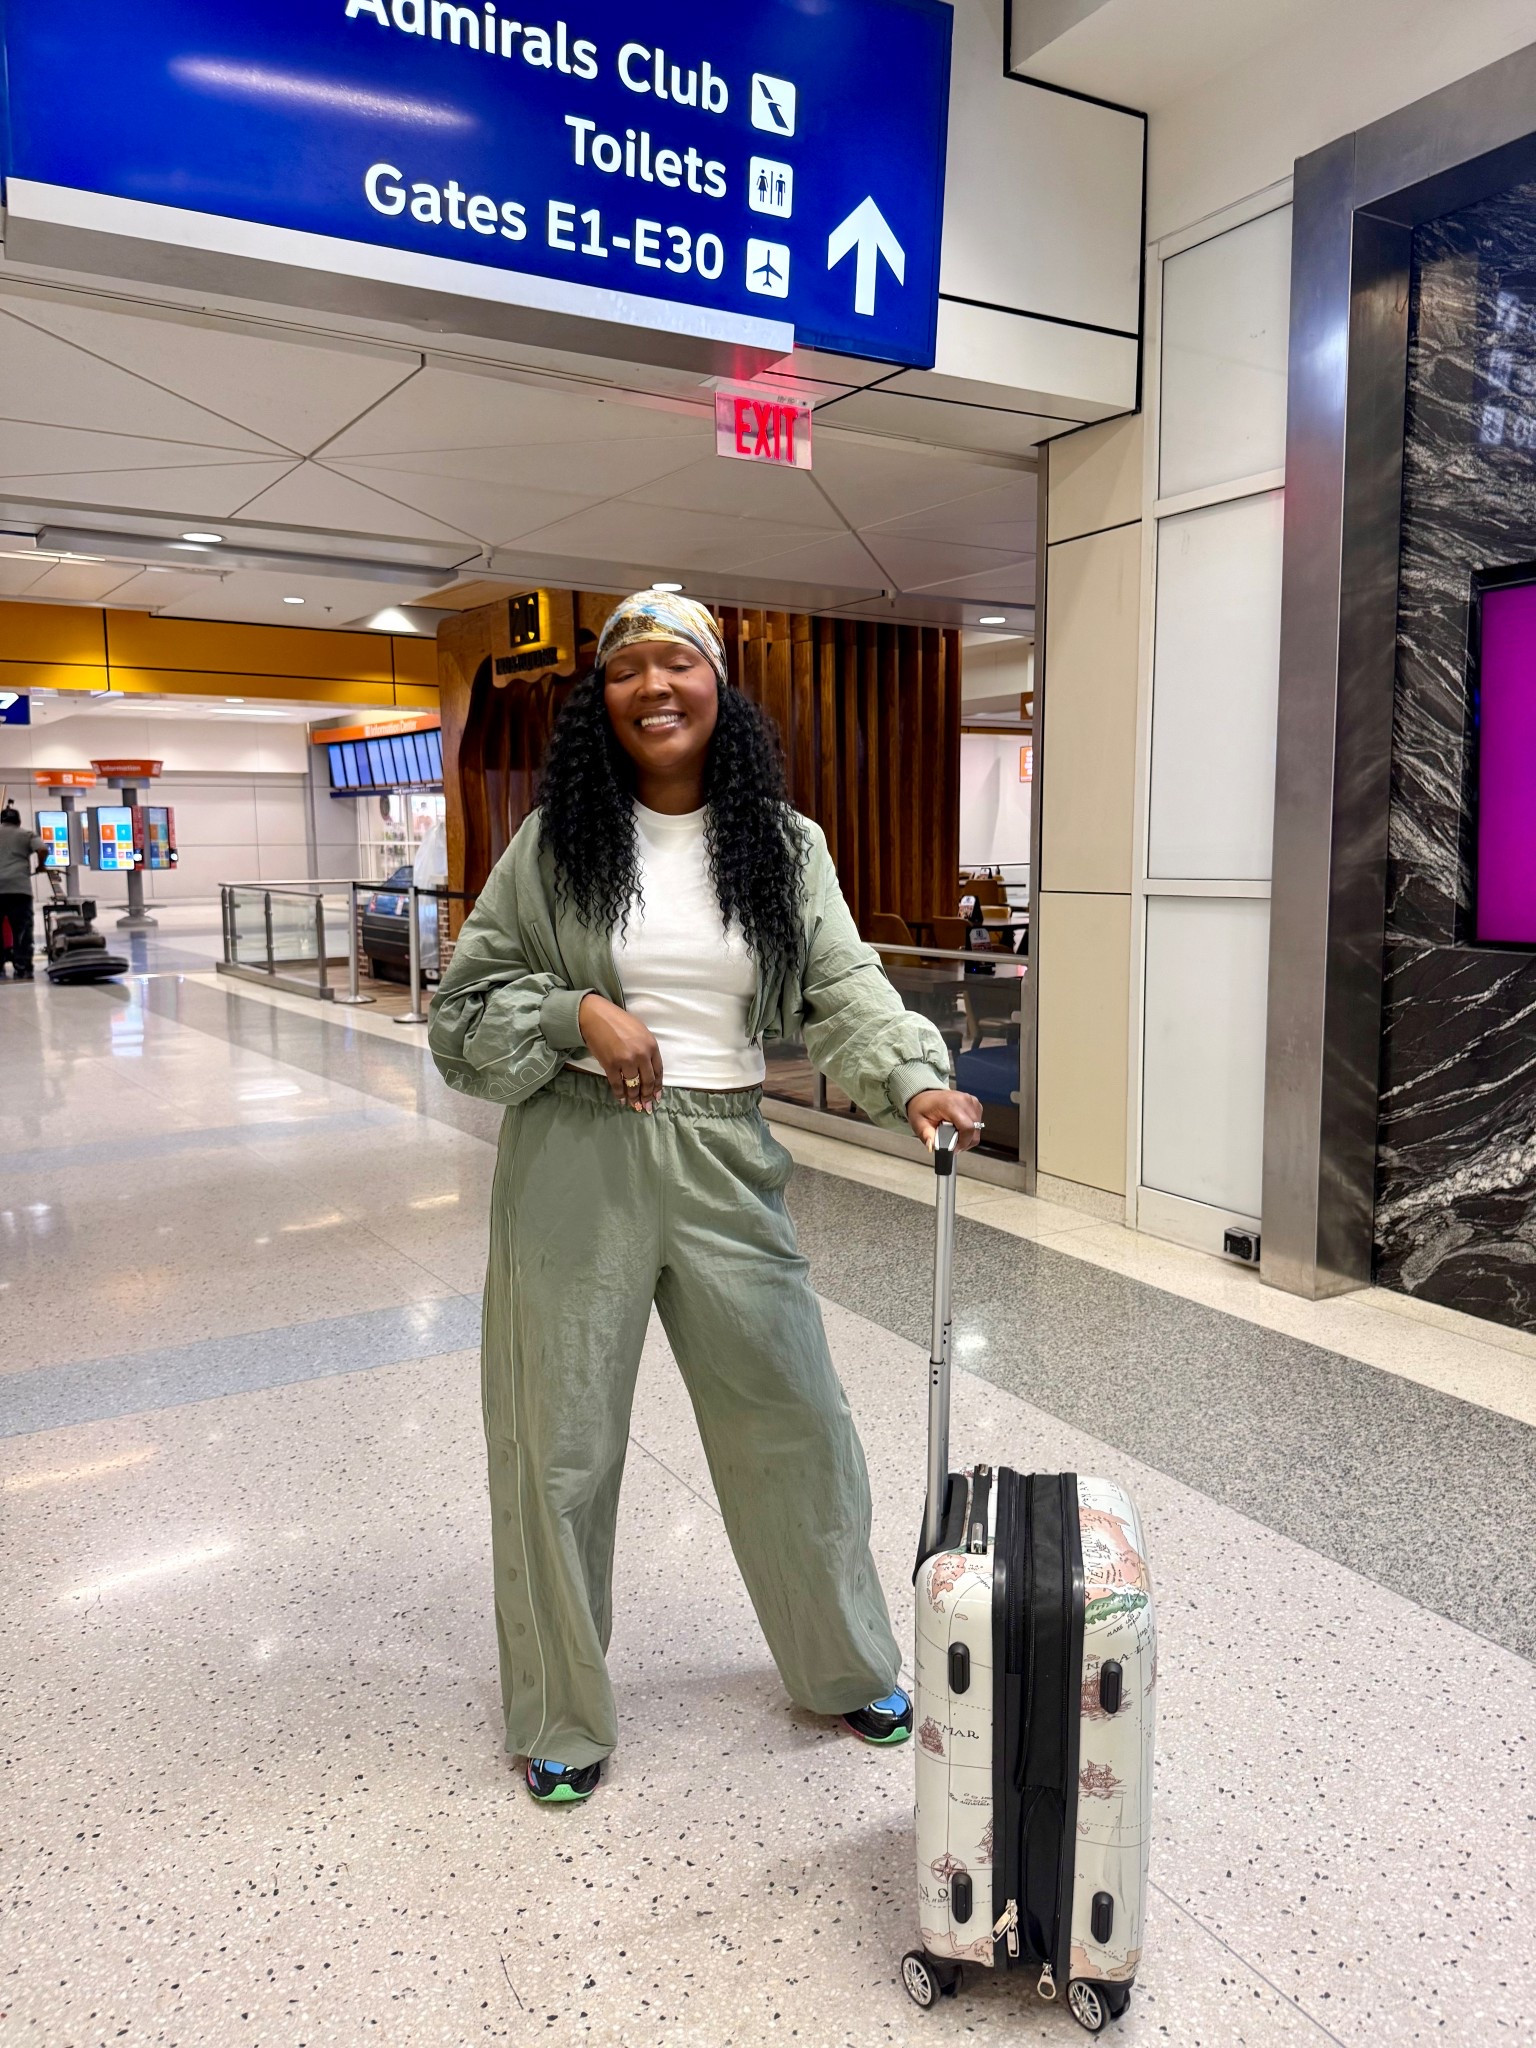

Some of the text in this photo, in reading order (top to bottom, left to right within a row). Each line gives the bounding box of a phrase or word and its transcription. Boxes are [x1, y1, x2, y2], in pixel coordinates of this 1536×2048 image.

[344, 0, 729, 114] Admirals Club
[564, 114, 727, 198] Toilets
[364, 163, 724, 280] Gates E1-E30
[733, 398, 798, 462] EXIT
[941, 1724, 980, 1740] MAR
